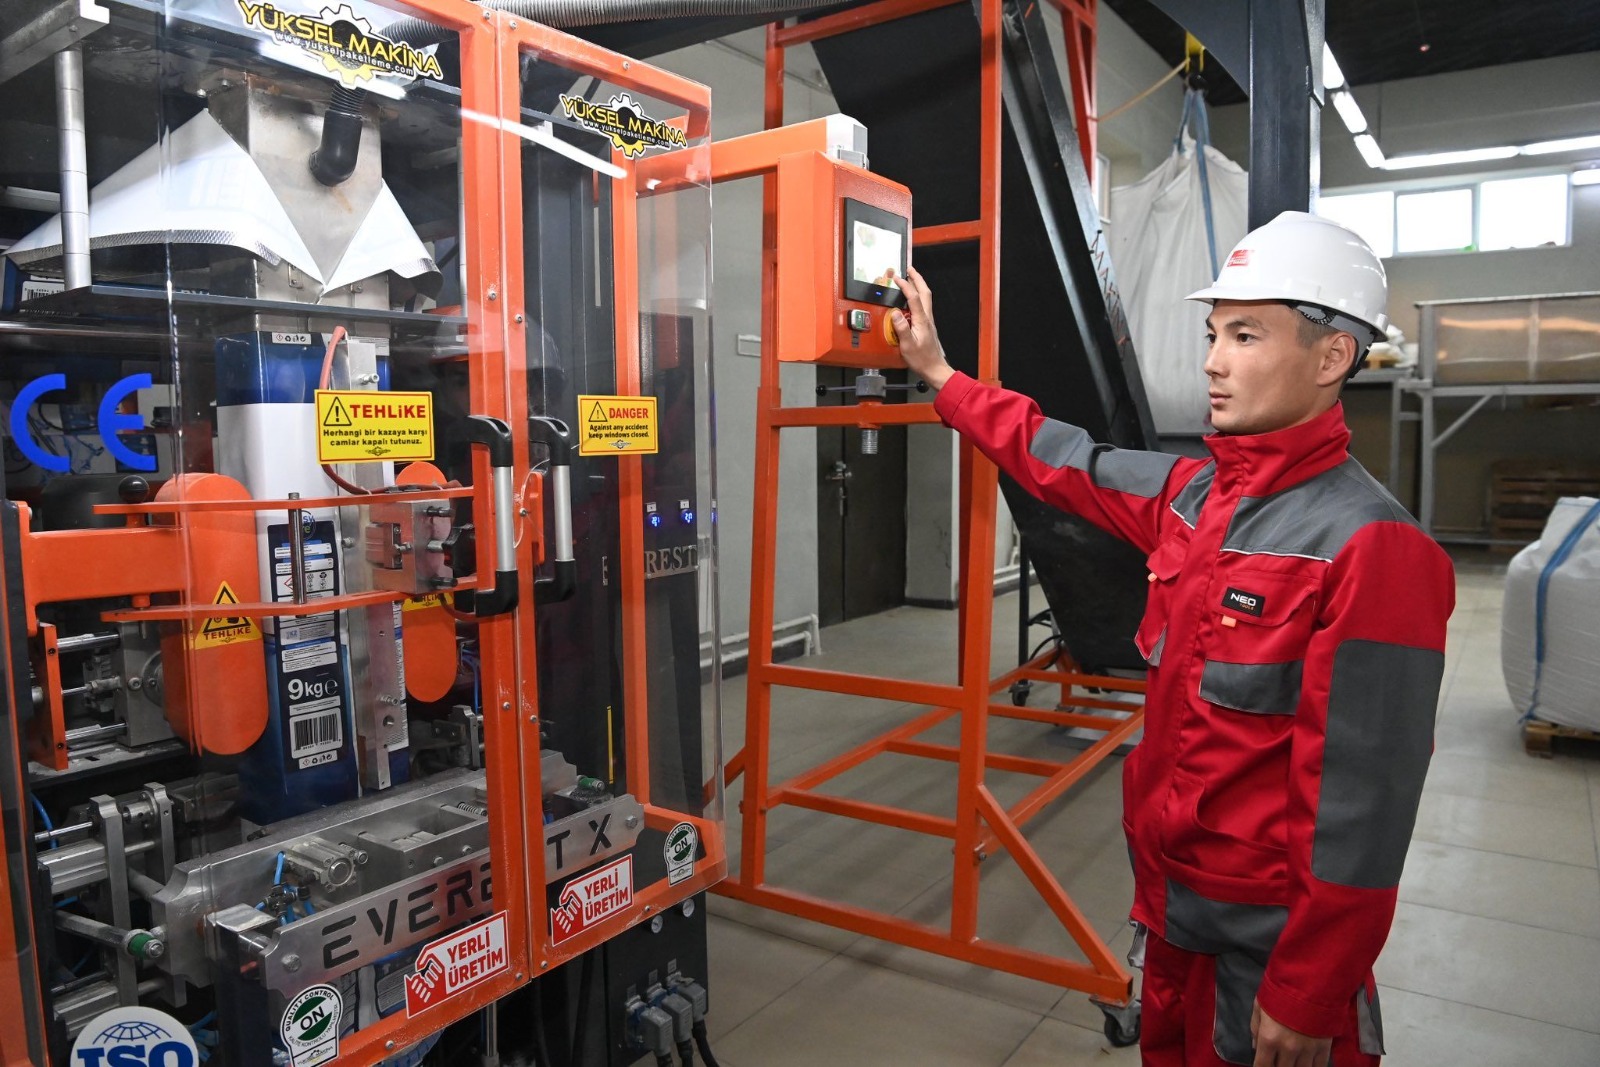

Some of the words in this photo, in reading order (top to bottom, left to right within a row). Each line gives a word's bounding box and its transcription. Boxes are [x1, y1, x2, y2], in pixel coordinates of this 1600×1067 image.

[239, 0, 342, 48] YÜKSEL
[349, 34, 442, 77] MAKİNA
[562, 96, 625, 129] YÜKSEL
[629, 118, 687, 147] MAKİNA
[589, 424, 612, 432] Against
[609, 408, 649, 419] DANGER
[323, 429, 362, 437] Herhangi
[378, 429, 406, 437] kazaya
[362, 438, 387, 446] kapalı
[1230, 592, 1257, 607] NEO
[588, 813, 612, 856] X
[674, 837, 688, 854] ON
[584, 867, 619, 900] YERLİ
[585, 887, 629, 921] ÜRETİM
[446, 925, 490, 965] YERLİ
[448, 947, 504, 988] ÜRETİM
[285, 999, 303, 1032] QUALITY
[304, 990, 334, 1001] CONTROL
[300, 1005, 325, 1031] ON
